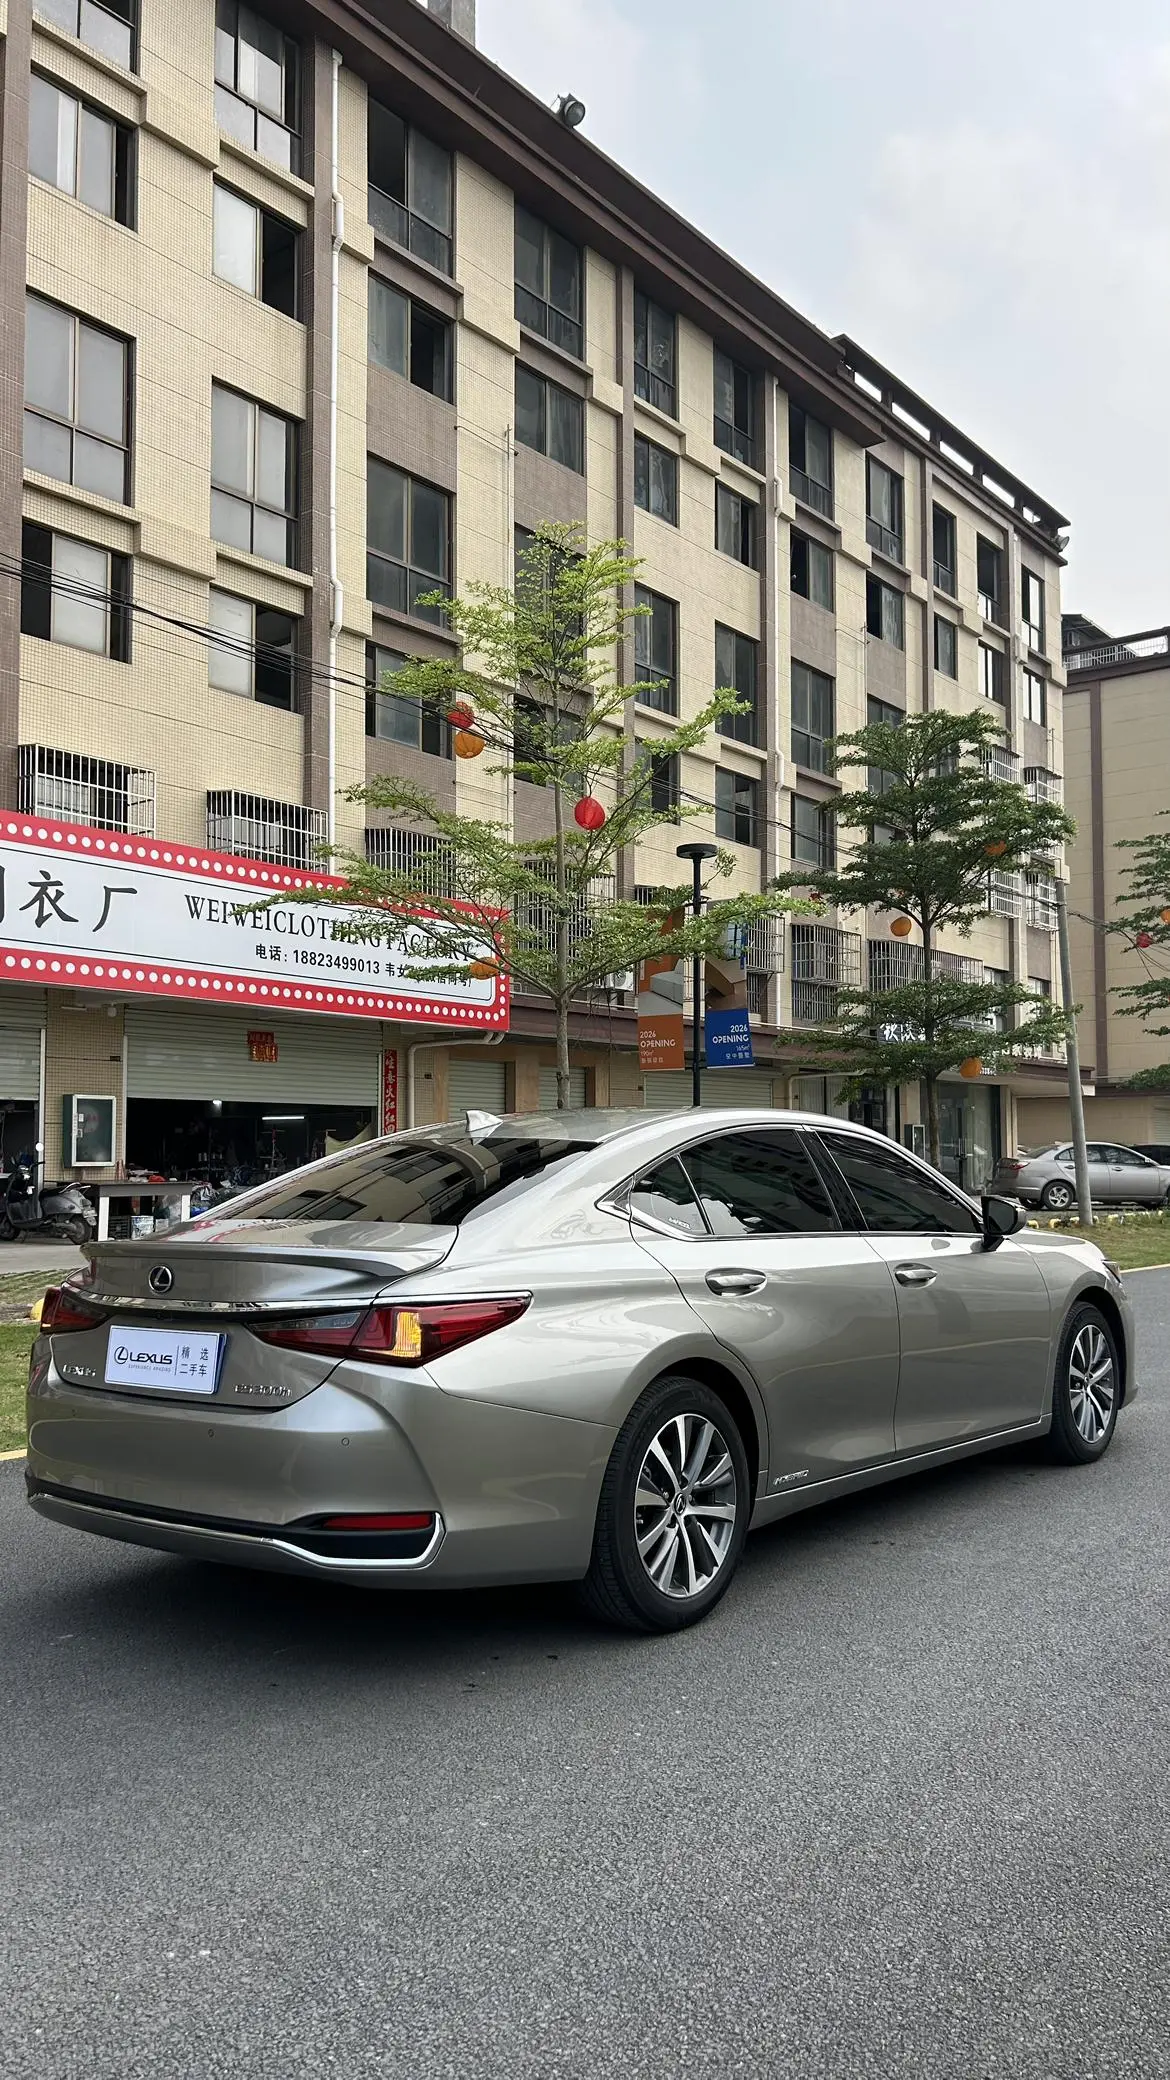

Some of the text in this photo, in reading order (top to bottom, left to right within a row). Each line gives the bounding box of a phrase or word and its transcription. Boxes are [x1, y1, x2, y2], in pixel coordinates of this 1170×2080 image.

[0, 865, 137, 932] 衣厂
[293, 949, 380, 974] 18823499013
[729, 1024, 748, 1033] 2026
[639, 1030, 657, 1039] 2026
[712, 1034, 749, 1044] OPENING
[640, 1039, 676, 1048] OPENING
[129, 1352, 173, 1365] LEXUS
[179, 1363, 207, 1377] 二手车
